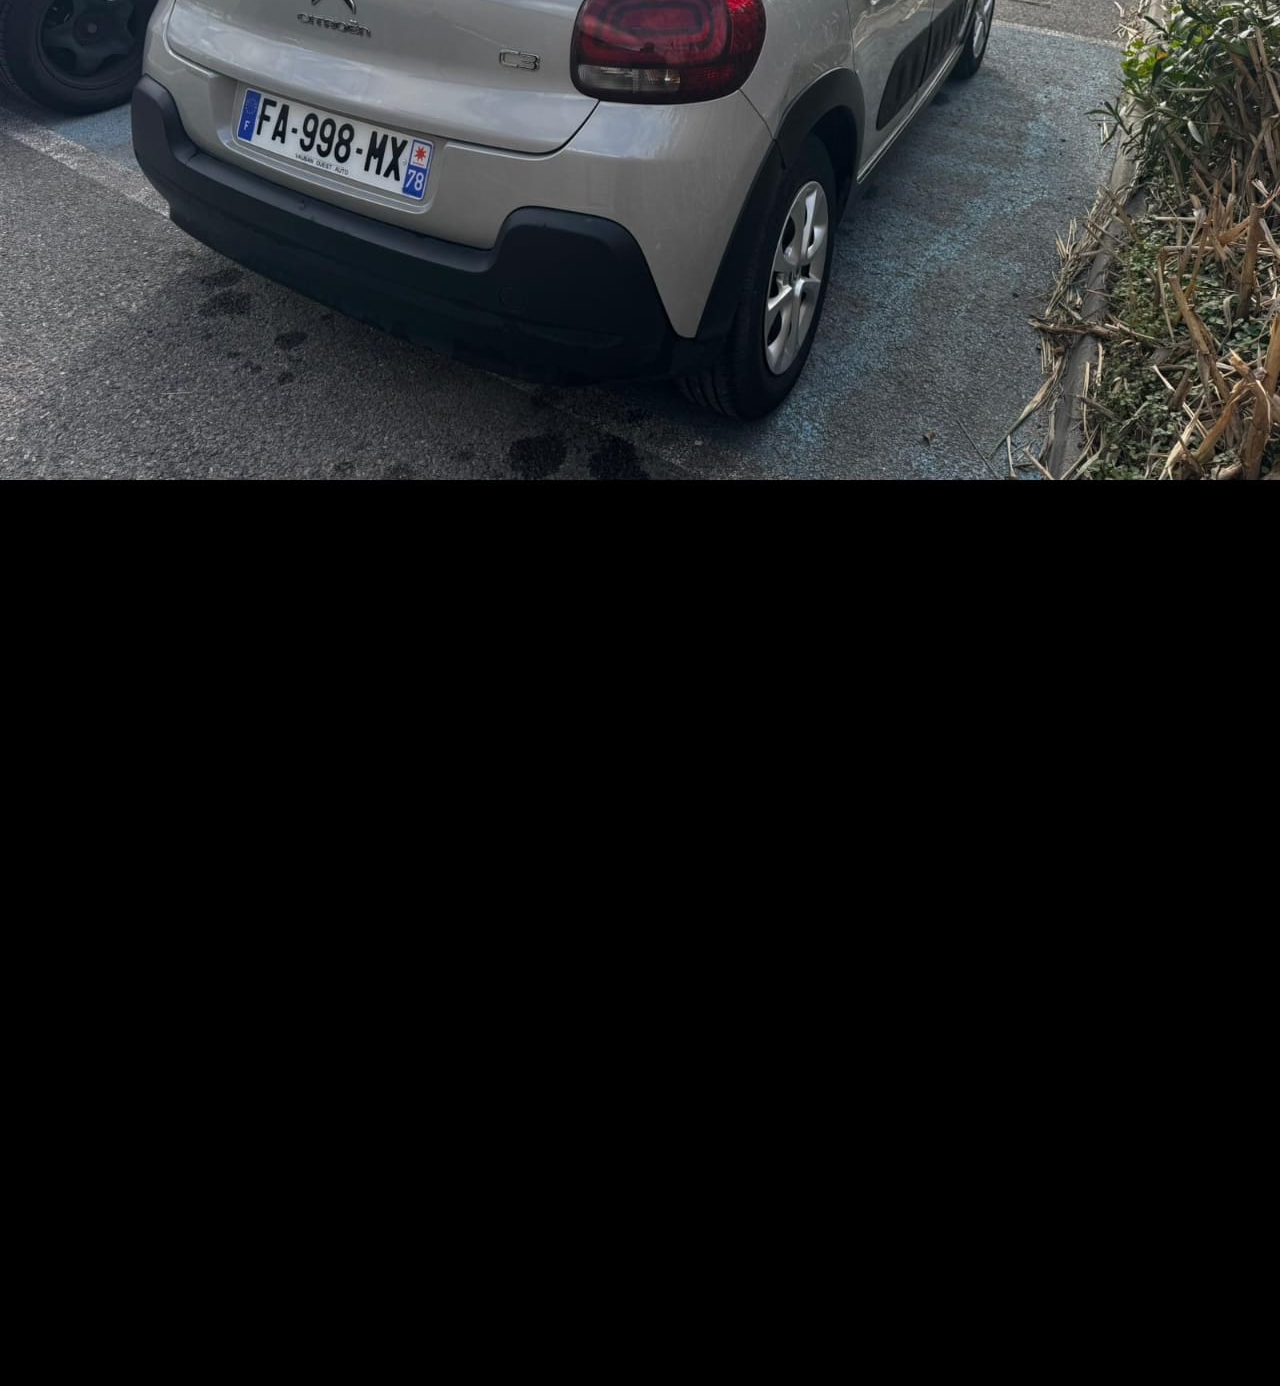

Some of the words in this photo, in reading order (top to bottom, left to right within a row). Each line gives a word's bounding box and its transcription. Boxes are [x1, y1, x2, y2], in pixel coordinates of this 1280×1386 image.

[499, 49, 540, 71] C3
[243, 120, 250, 130] F
[256, 98, 408, 181] FA-998-MX
[335, 165, 349, 175] AUTO
[405, 168, 424, 191] 78
